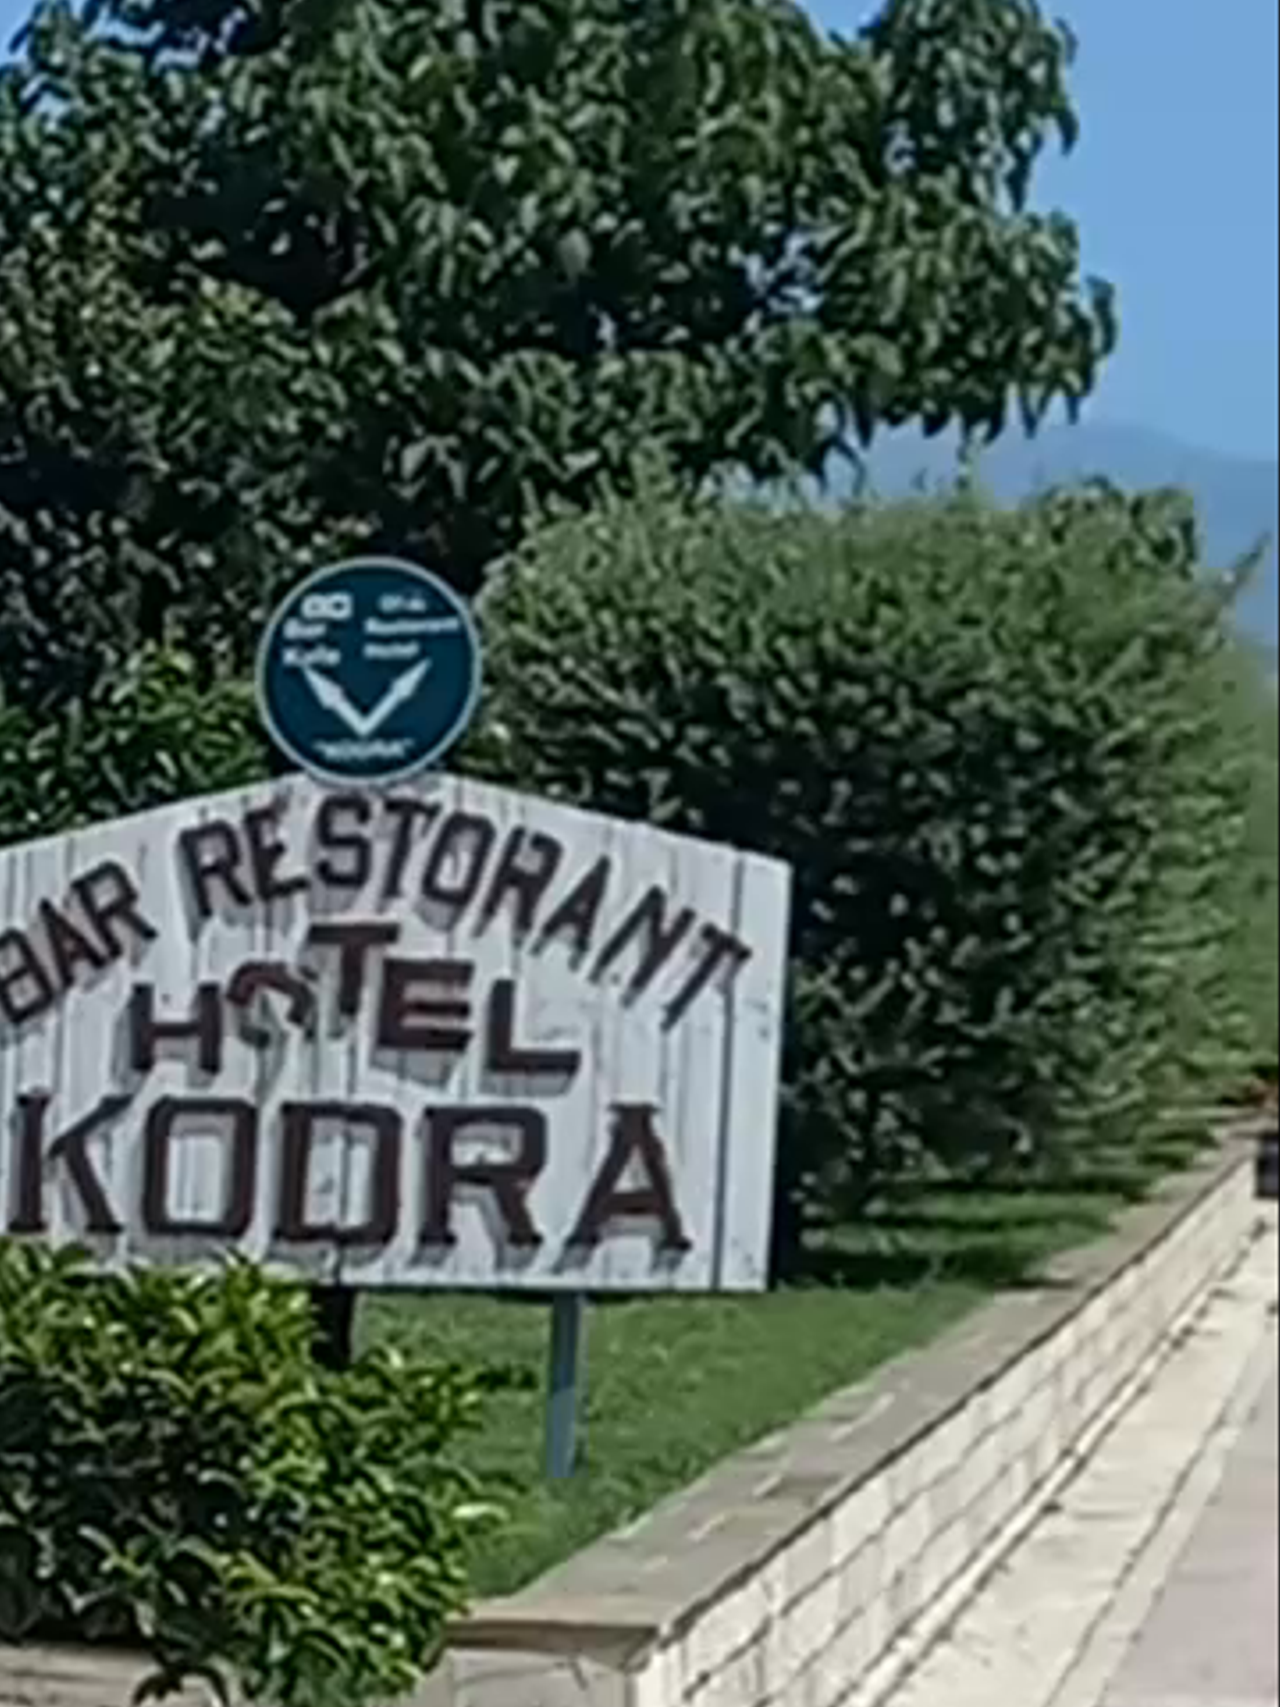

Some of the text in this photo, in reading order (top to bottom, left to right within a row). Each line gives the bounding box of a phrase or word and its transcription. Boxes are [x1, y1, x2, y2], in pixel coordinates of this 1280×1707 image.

[180, 796, 752, 1031] RESTORANT
[129, 923, 581, 1073] HOTEL
[7, 1093, 692, 1252] KODRA
